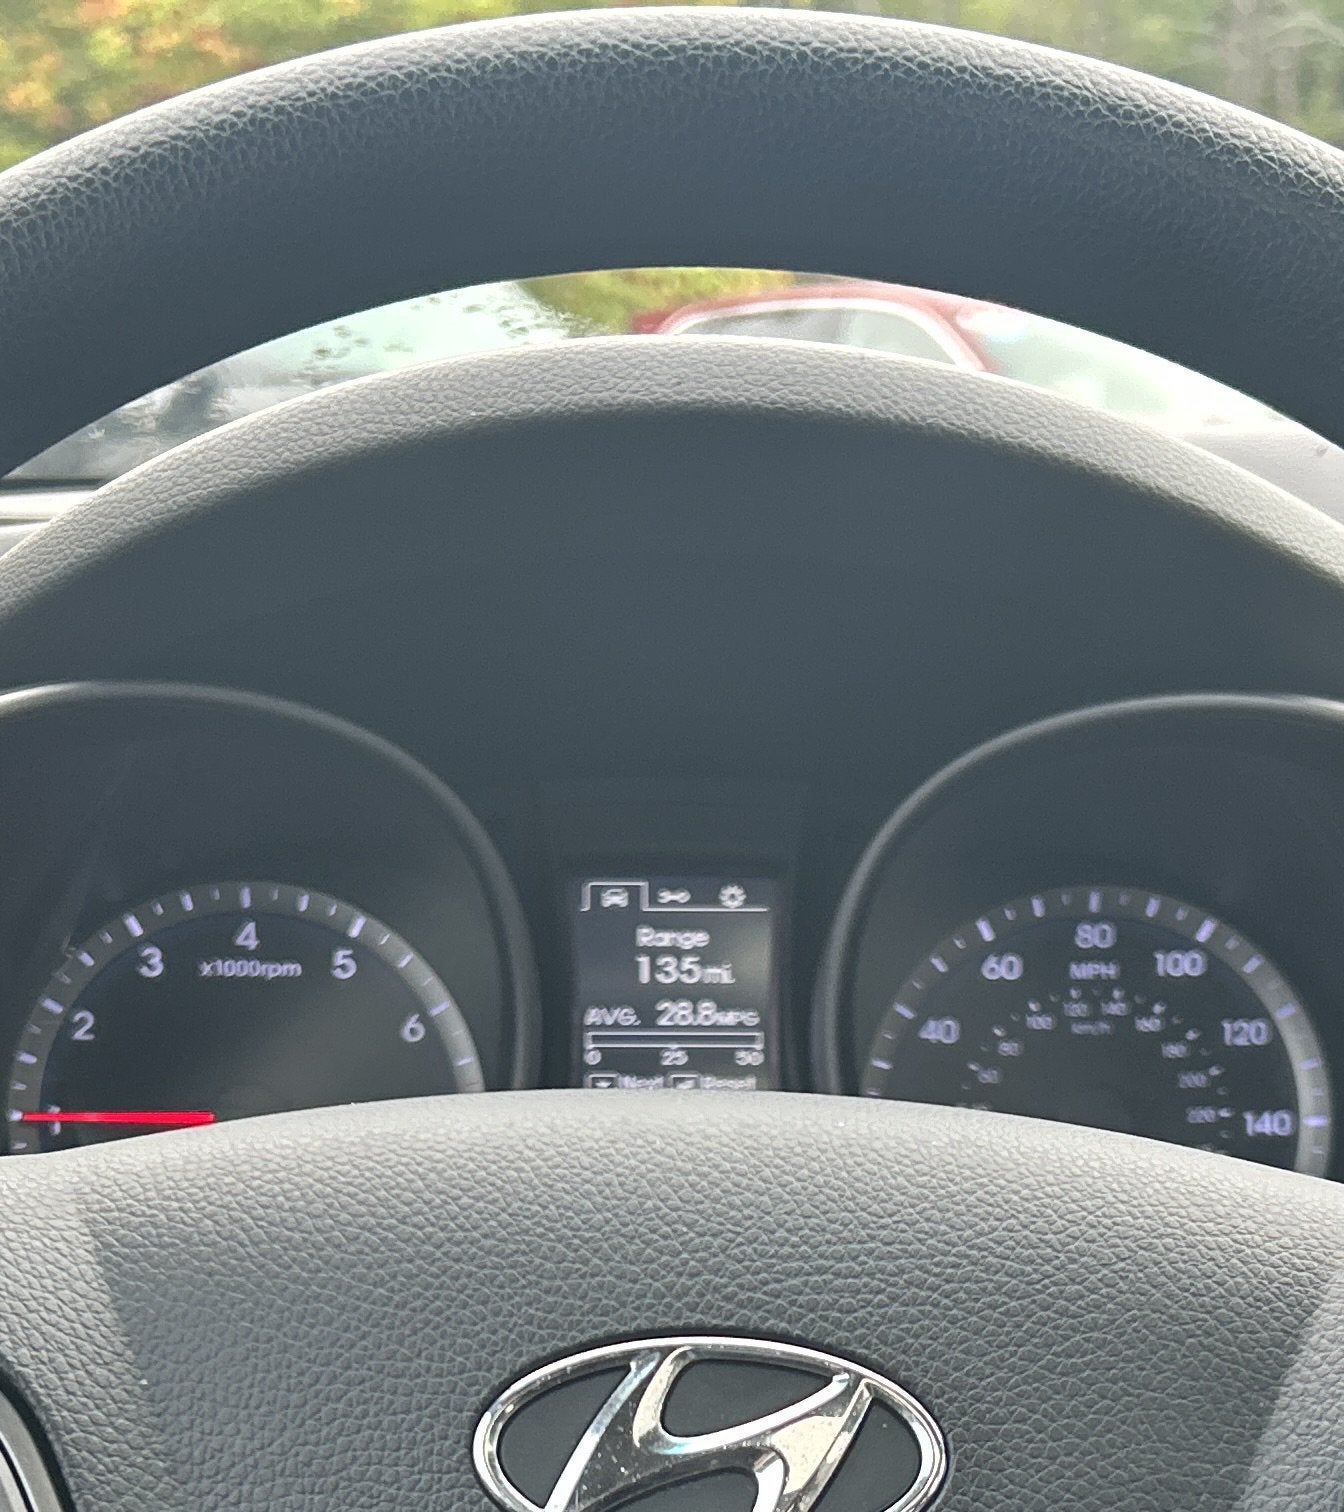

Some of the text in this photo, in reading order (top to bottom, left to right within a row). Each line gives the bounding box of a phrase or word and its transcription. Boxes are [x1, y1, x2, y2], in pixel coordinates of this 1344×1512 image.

[234, 922, 259, 950] 4
[635, 925, 710, 949] Range
[1074, 922, 1116, 949] 80
[137, 946, 165, 978] 3
[331, 948, 357, 979] 5
[980, 954, 1024, 981] 60
[1155, 950, 1208, 977] 100
[72, 1010, 96, 1041] 2
[400, 1013, 426, 1043] 6
[583, 1008, 642, 1026] AVG.
[918, 1017, 960, 1045] 40
[1222, 1018, 1272, 1047] 120
[1244, 1109, 1294, 1137] 140
